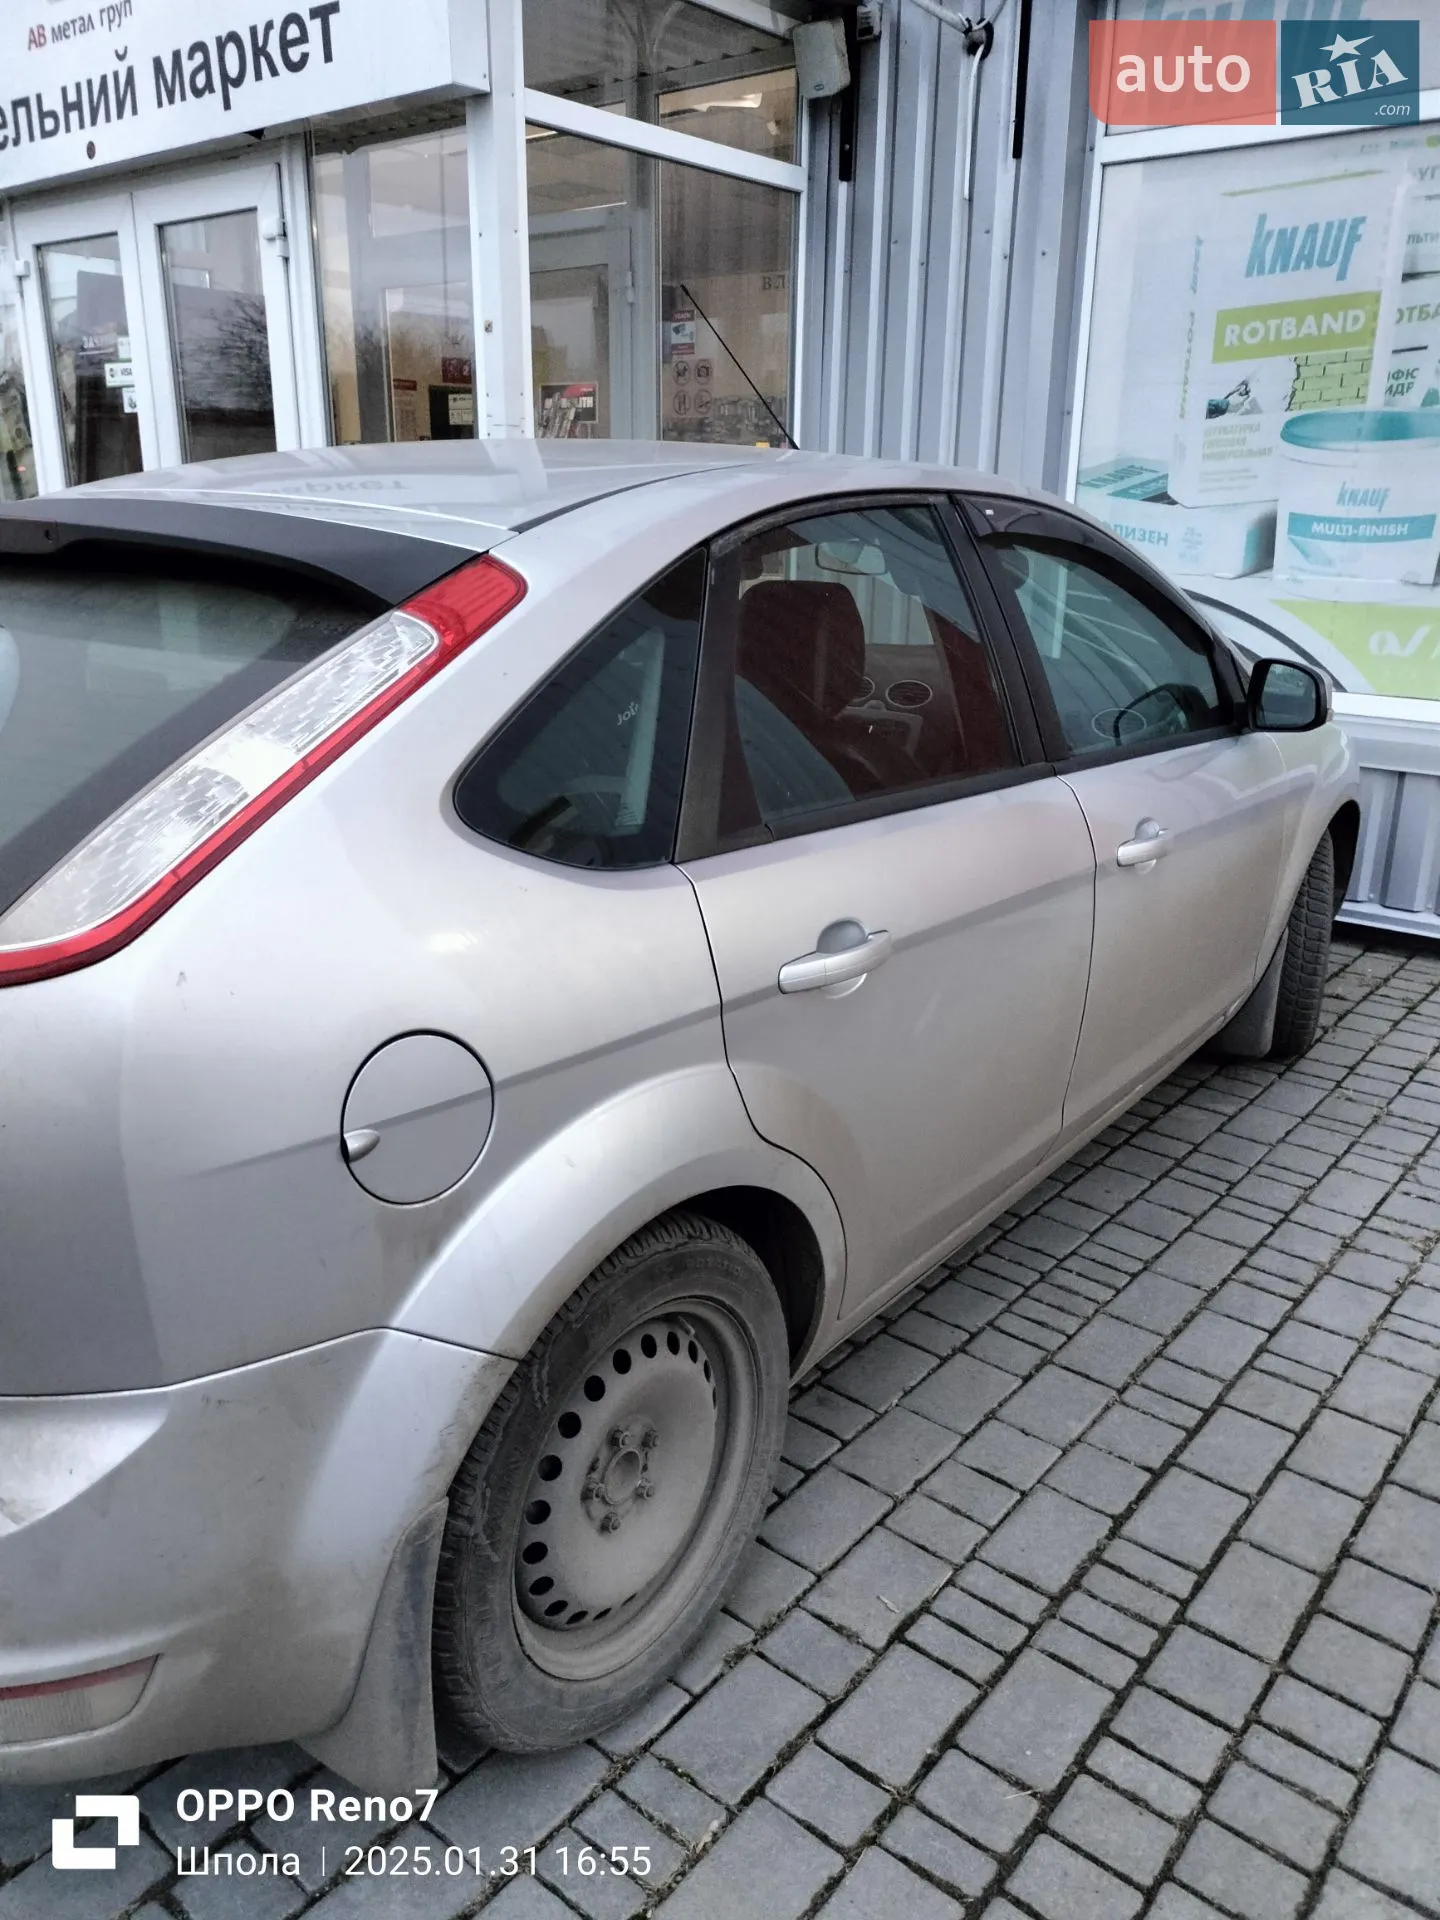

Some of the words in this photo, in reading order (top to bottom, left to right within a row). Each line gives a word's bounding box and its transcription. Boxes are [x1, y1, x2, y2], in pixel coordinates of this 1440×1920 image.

[51, 13, 95, 44] метал
[100, 0, 133, 32] груп
[152, 1, 341, 111] маркет
[1245, 213, 1367, 281] KNAUF
[1223, 309, 1367, 347] ROTBAND
[1336, 481, 1391, 512] KNAUF
[1311, 521, 1409, 537] MULTI-FINISH
